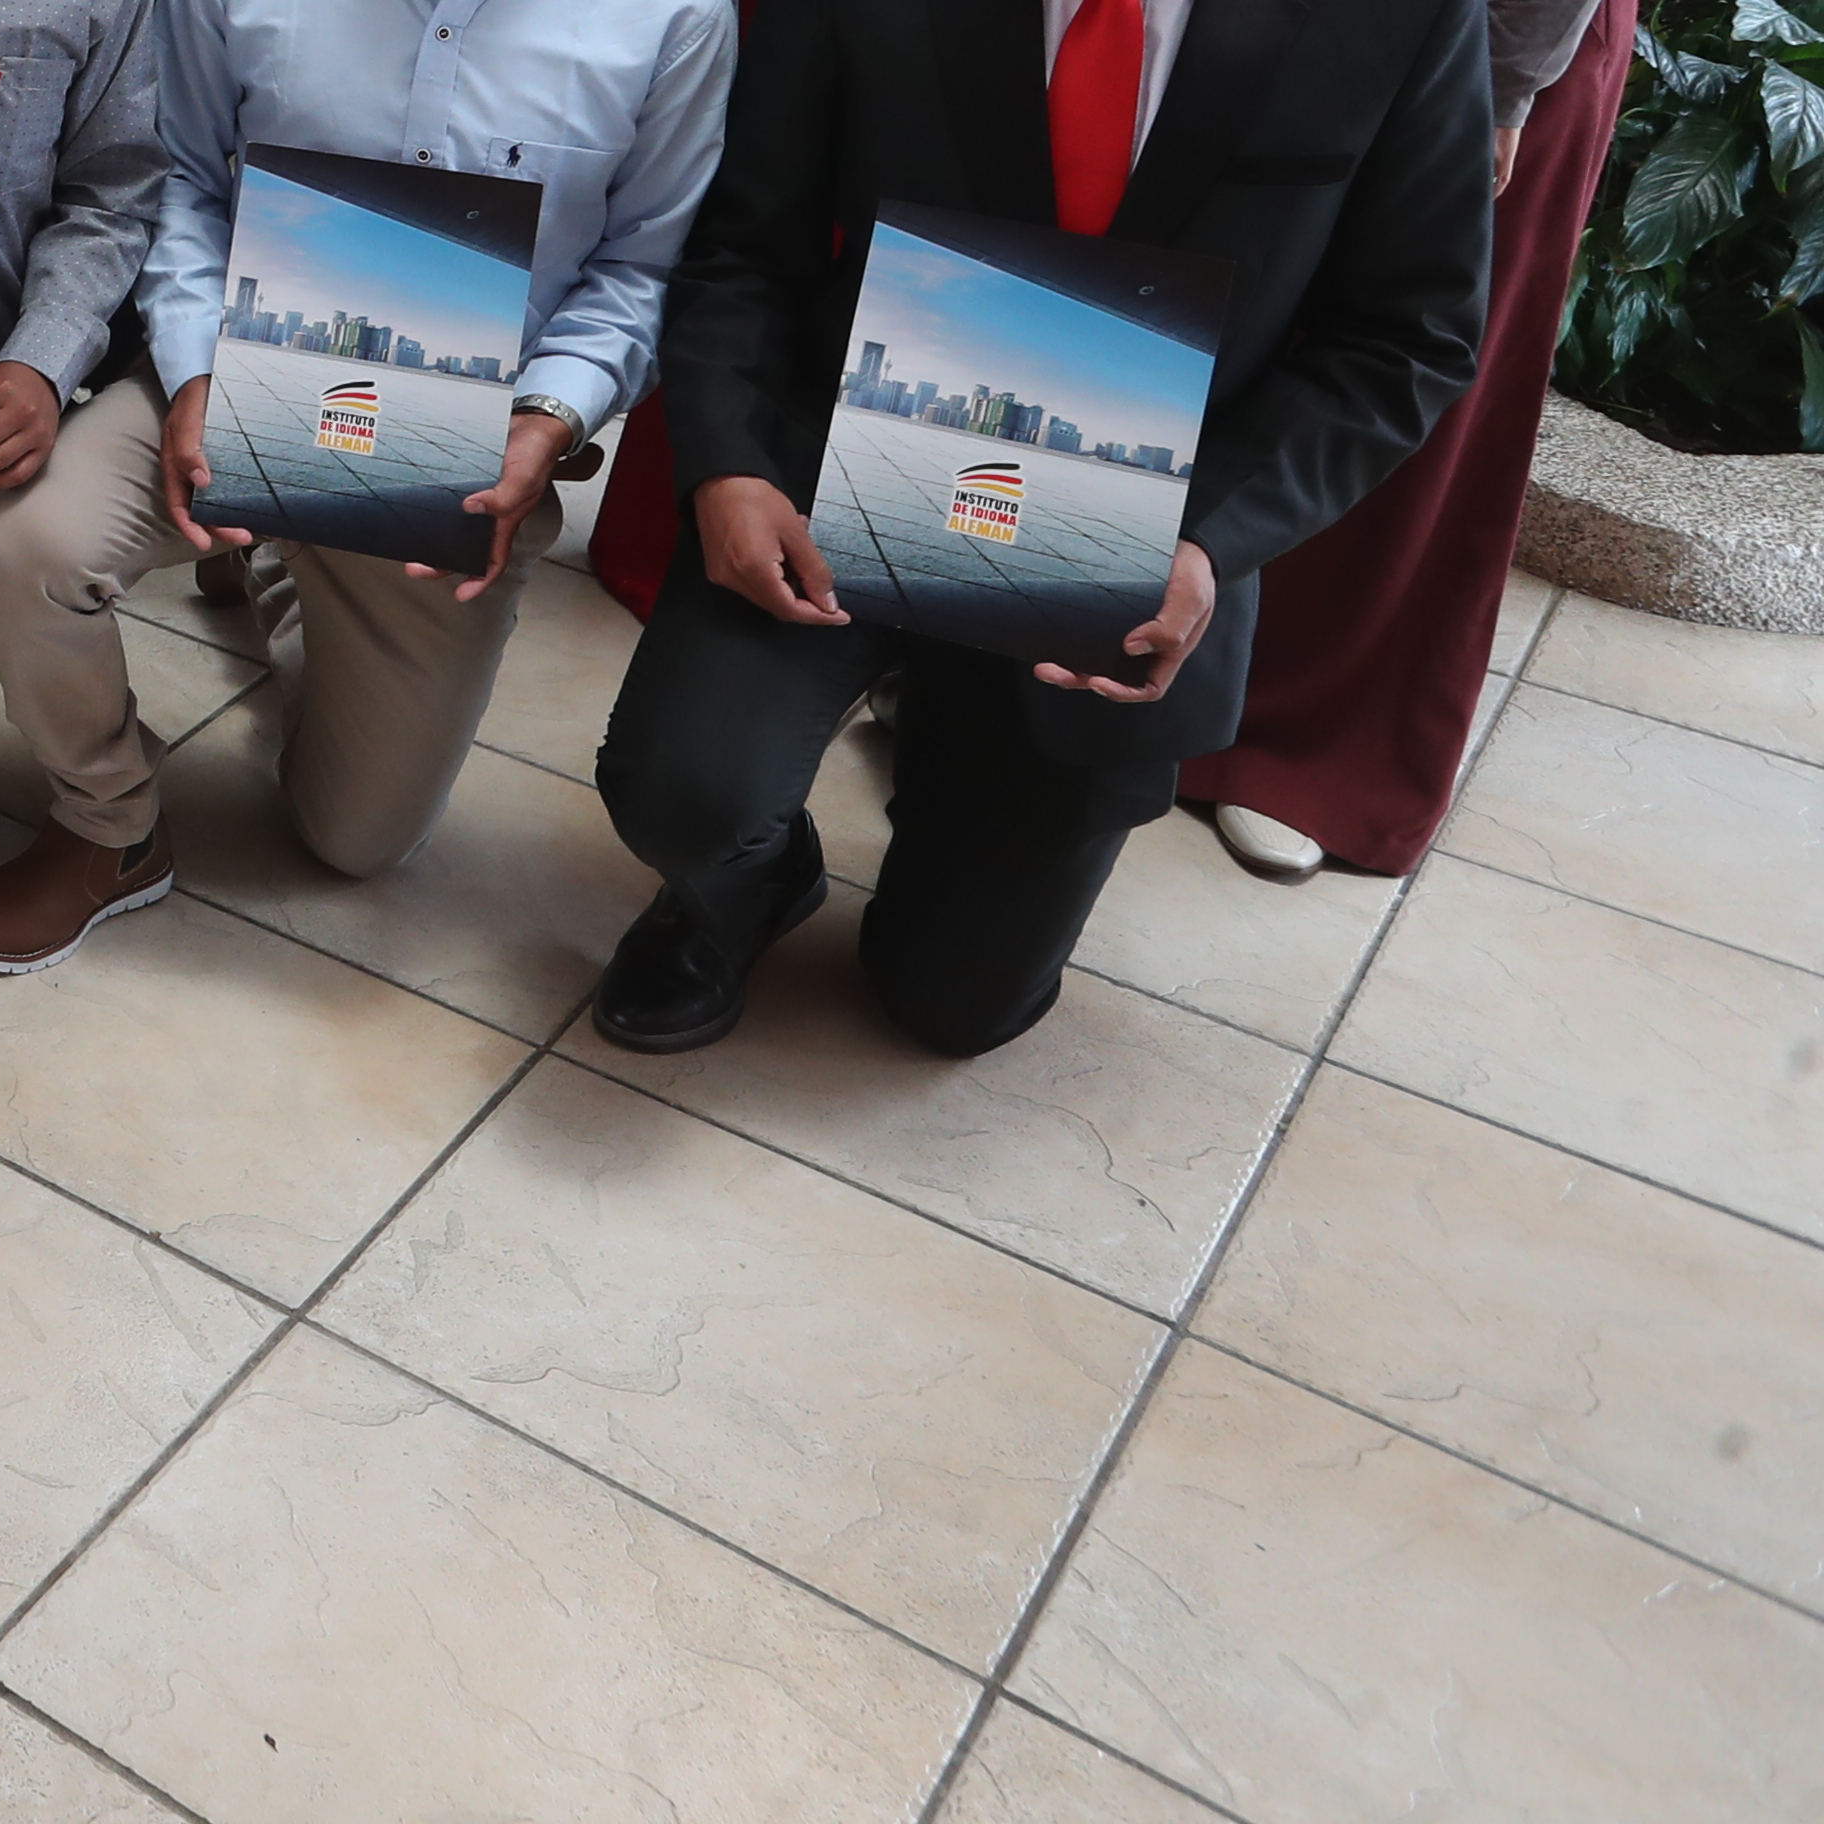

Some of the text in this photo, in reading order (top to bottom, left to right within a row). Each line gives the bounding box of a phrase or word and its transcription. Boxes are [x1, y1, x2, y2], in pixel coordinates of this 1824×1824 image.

[322, 409, 375, 427] INSTITUTO
[320, 420, 374, 438] DE IDIOMA
[955, 490, 1019, 514] INSTITUTO
[953, 502, 1016, 526] DE IDIOMA
